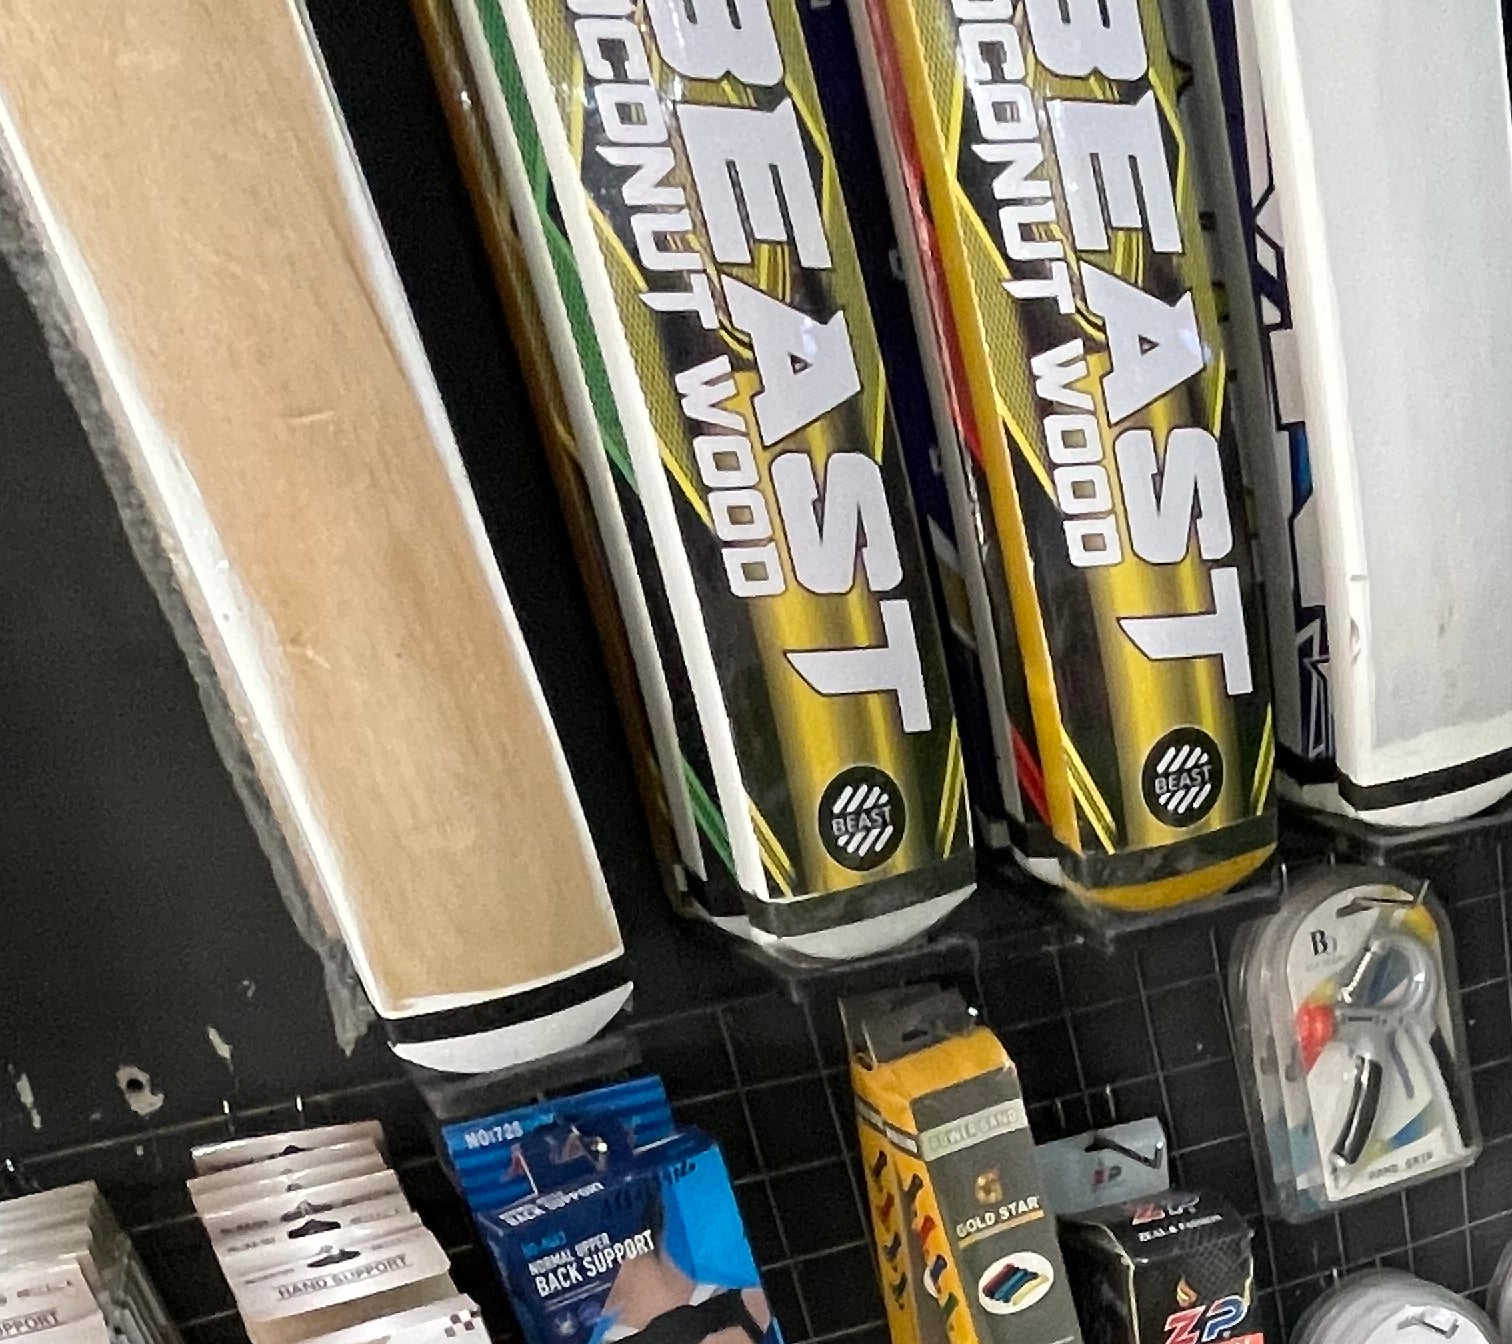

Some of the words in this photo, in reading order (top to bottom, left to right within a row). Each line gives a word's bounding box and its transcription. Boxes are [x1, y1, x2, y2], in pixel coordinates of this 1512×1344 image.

[567, 0, 726, 331] CONUT
[675, 355, 786, 599] WOOD
[952, 0, 1075, 327] CONUT
[1031, 341, 1121, 568] WOOD
[1154, 756, 1213, 797] BEAST
[830, 805, 893, 839] BEAST
[956, 1211, 995, 1238] GOLD
[999, 1196, 1040, 1220] STAR
[331, 1254, 408, 1285] SUPPORT
[535, 1261, 584, 1297] BACK
[582, 1229, 656, 1278] SUPPORT
